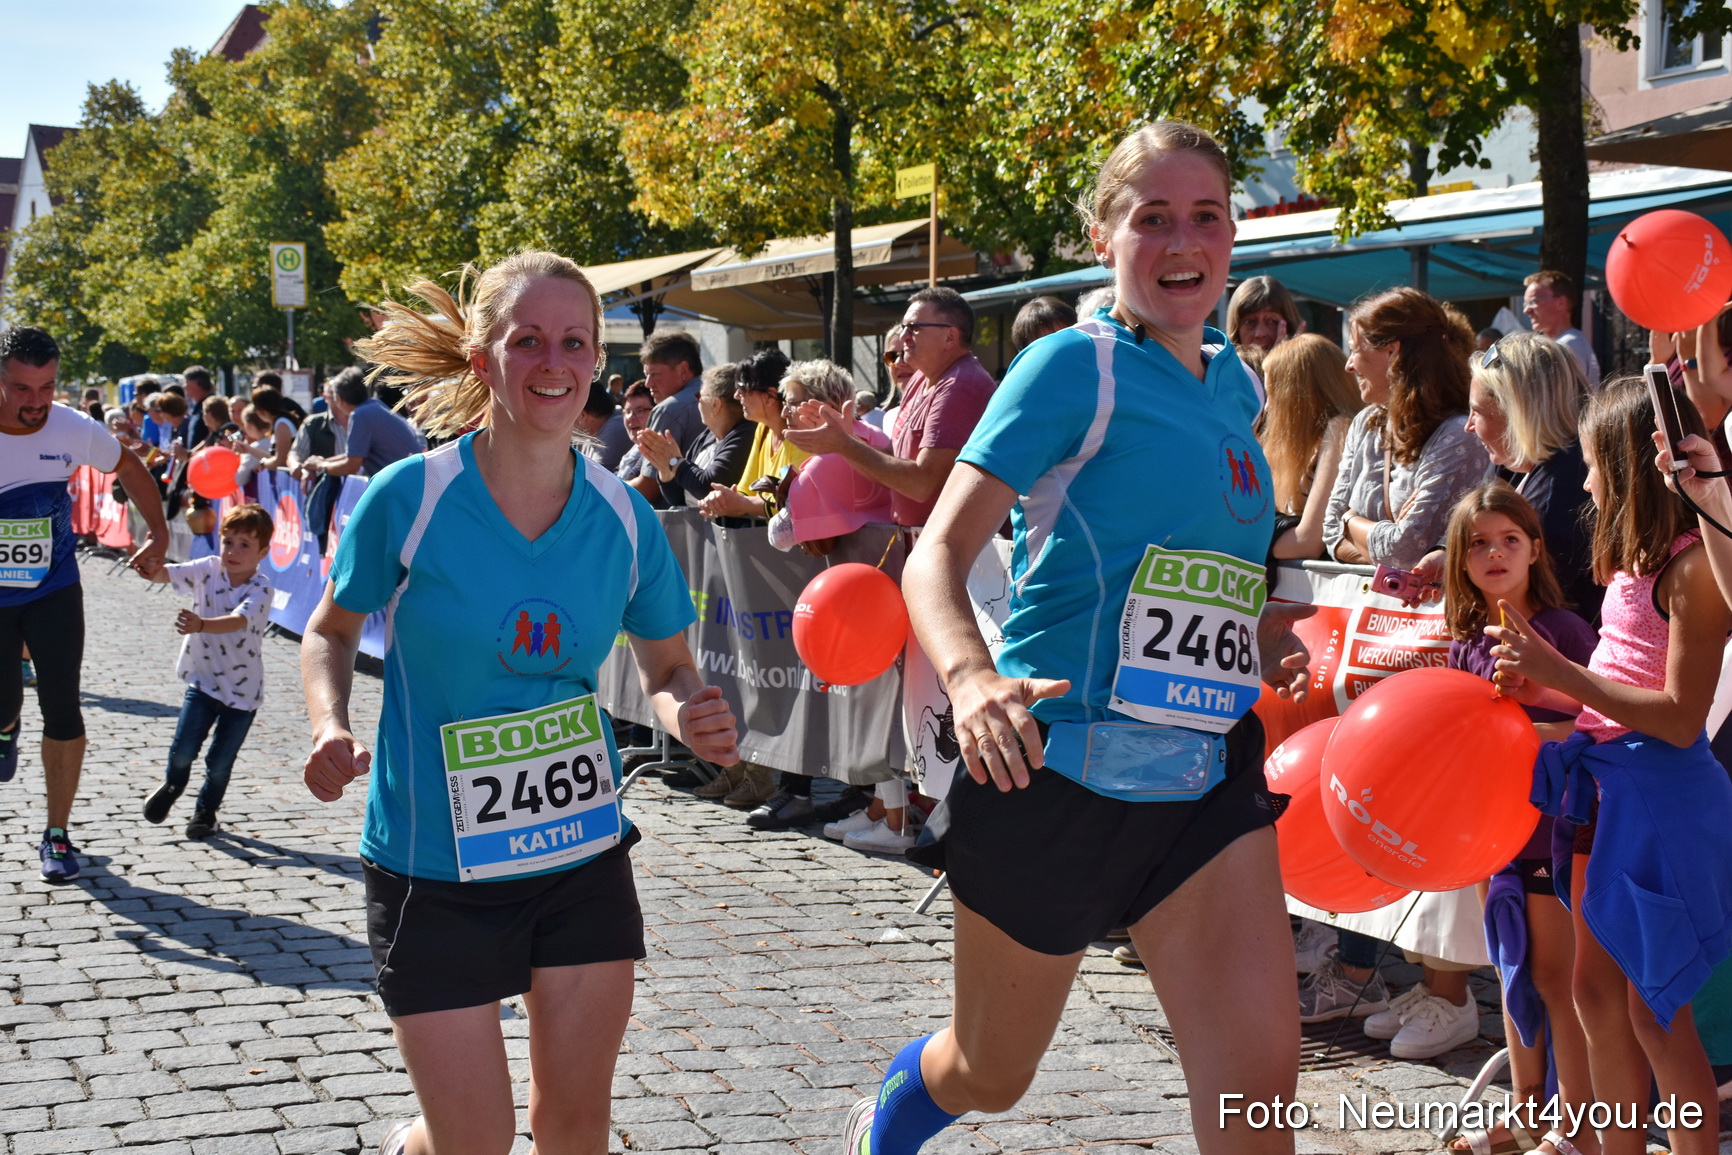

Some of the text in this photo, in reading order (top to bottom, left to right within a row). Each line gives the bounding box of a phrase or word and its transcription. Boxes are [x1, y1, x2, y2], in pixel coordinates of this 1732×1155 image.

[904, 175, 932, 189] Toiletten
[1147, 556, 1263, 607] BOCK
[1142, 607, 1252, 674] 2468
[1324, 629, 1339, 660] 1929
[1166, 682, 1236, 713] KATHI
[458, 706, 589, 761] BOCK
[472, 754, 598, 824] 2469
[508, 820, 583, 855] KATHI
[1368, 834, 1422, 868] energie
